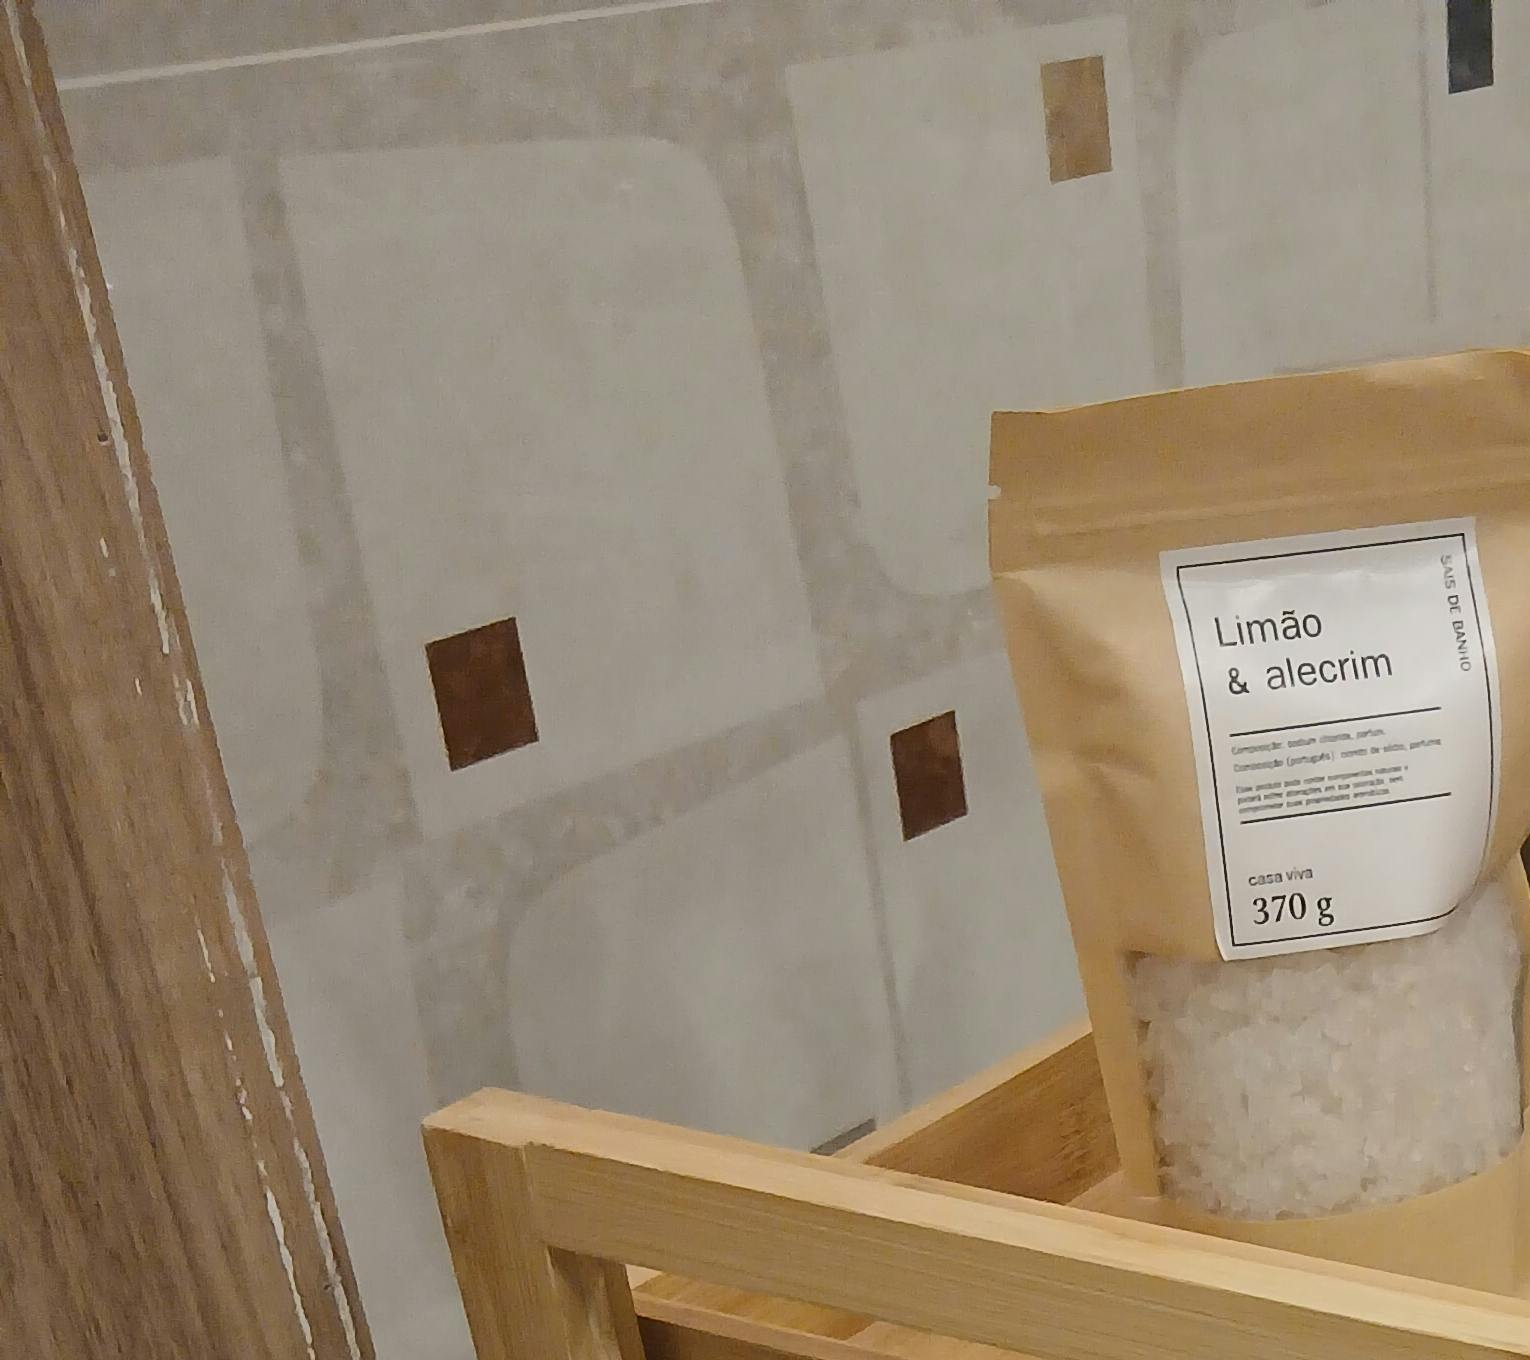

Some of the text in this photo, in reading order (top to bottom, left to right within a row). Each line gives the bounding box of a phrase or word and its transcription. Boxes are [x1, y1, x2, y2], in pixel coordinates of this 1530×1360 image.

[1447, 594, 1462, 616] DE
[1214, 609, 1323, 648] Limão
[1452, 619, 1473, 672] BANHO
[1227, 649, 1393, 695] & alecrim
[1248, 866, 1314, 887] casa viva
[1252, 892, 1335, 927] 370 g
